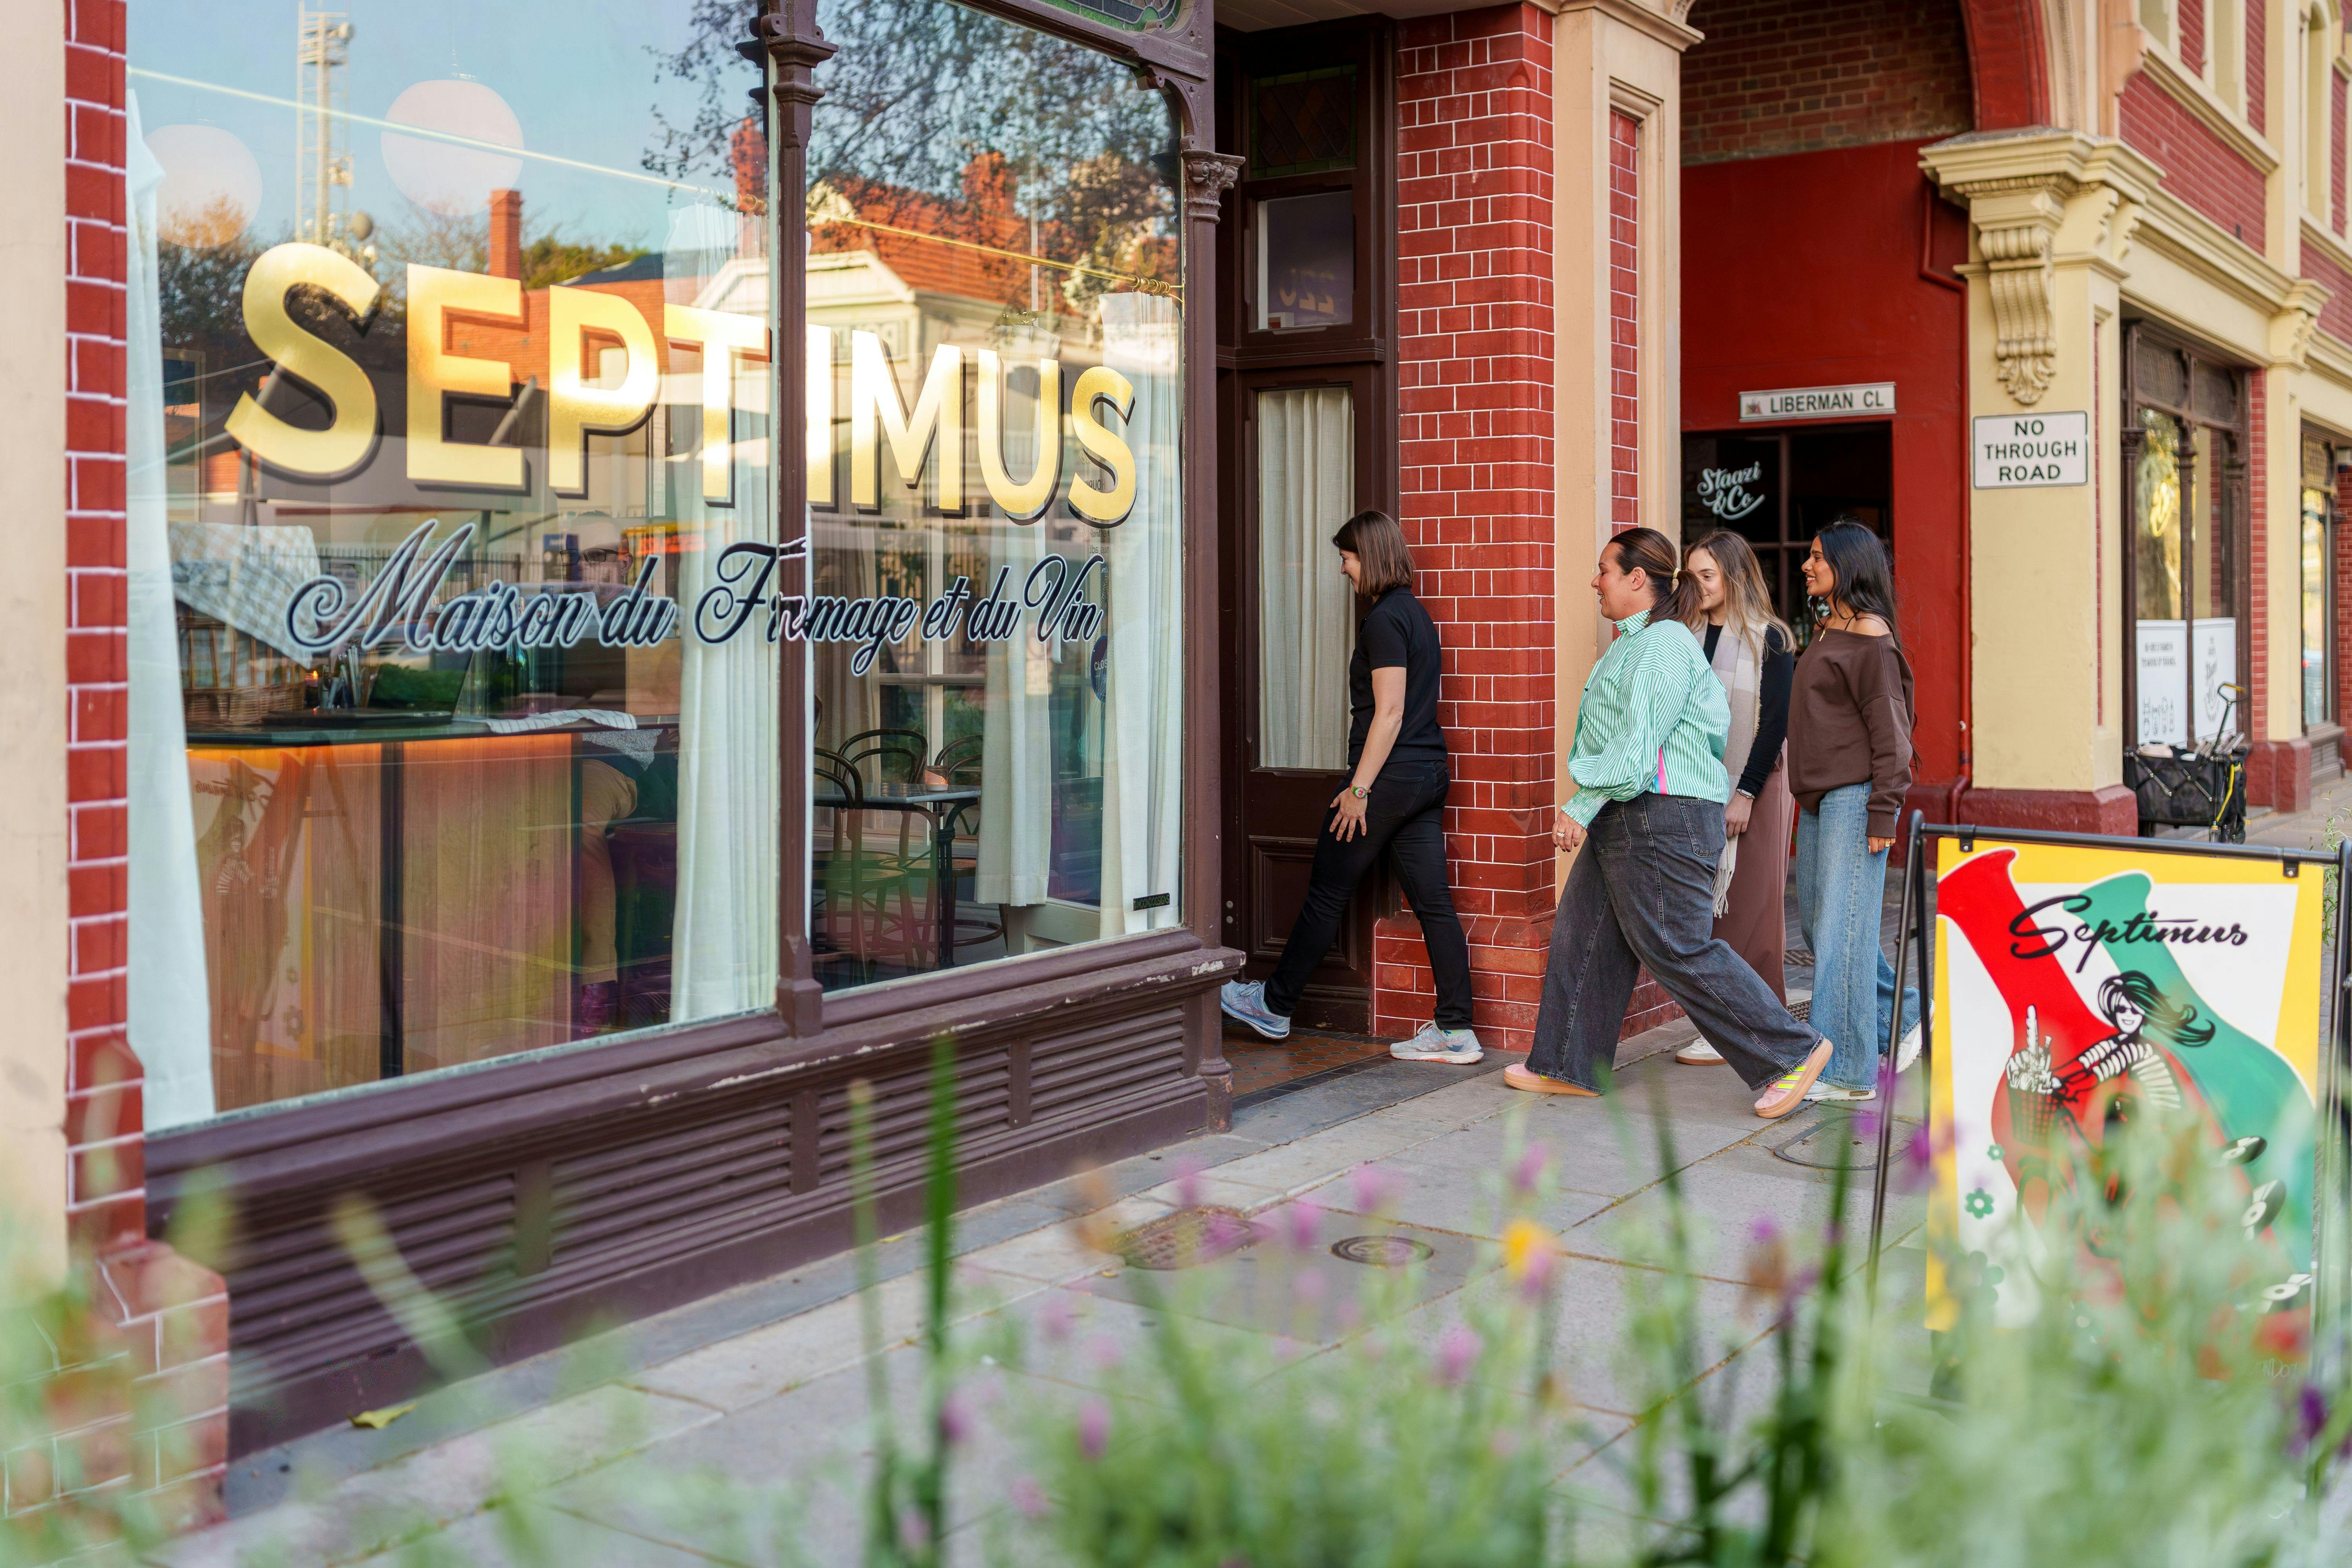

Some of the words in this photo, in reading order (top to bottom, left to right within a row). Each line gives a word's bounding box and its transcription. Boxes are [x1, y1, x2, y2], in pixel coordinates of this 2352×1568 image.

[224, 241, 1137, 528] SEPTIMUS
[1770, 391, 1853, 413] LIBERMAN
[1863, 389, 1884, 407] CL
[2014, 419, 2045, 436] NO
[1984, 440, 2076, 459] THROUGH
[1697, 461, 1762, 496] Staazi
[1999, 463, 2061, 481] ROAD
[285, 518, 593, 652] Maison
[597, 554, 675, 648] du
[921, 575, 970, 642] et
[967, 564, 1022, 642] du
[1023, 553, 1104, 643] Vin
[1094, 659, 1107, 671] CLOS
[2009, 894, 2248, 973] Septimus
